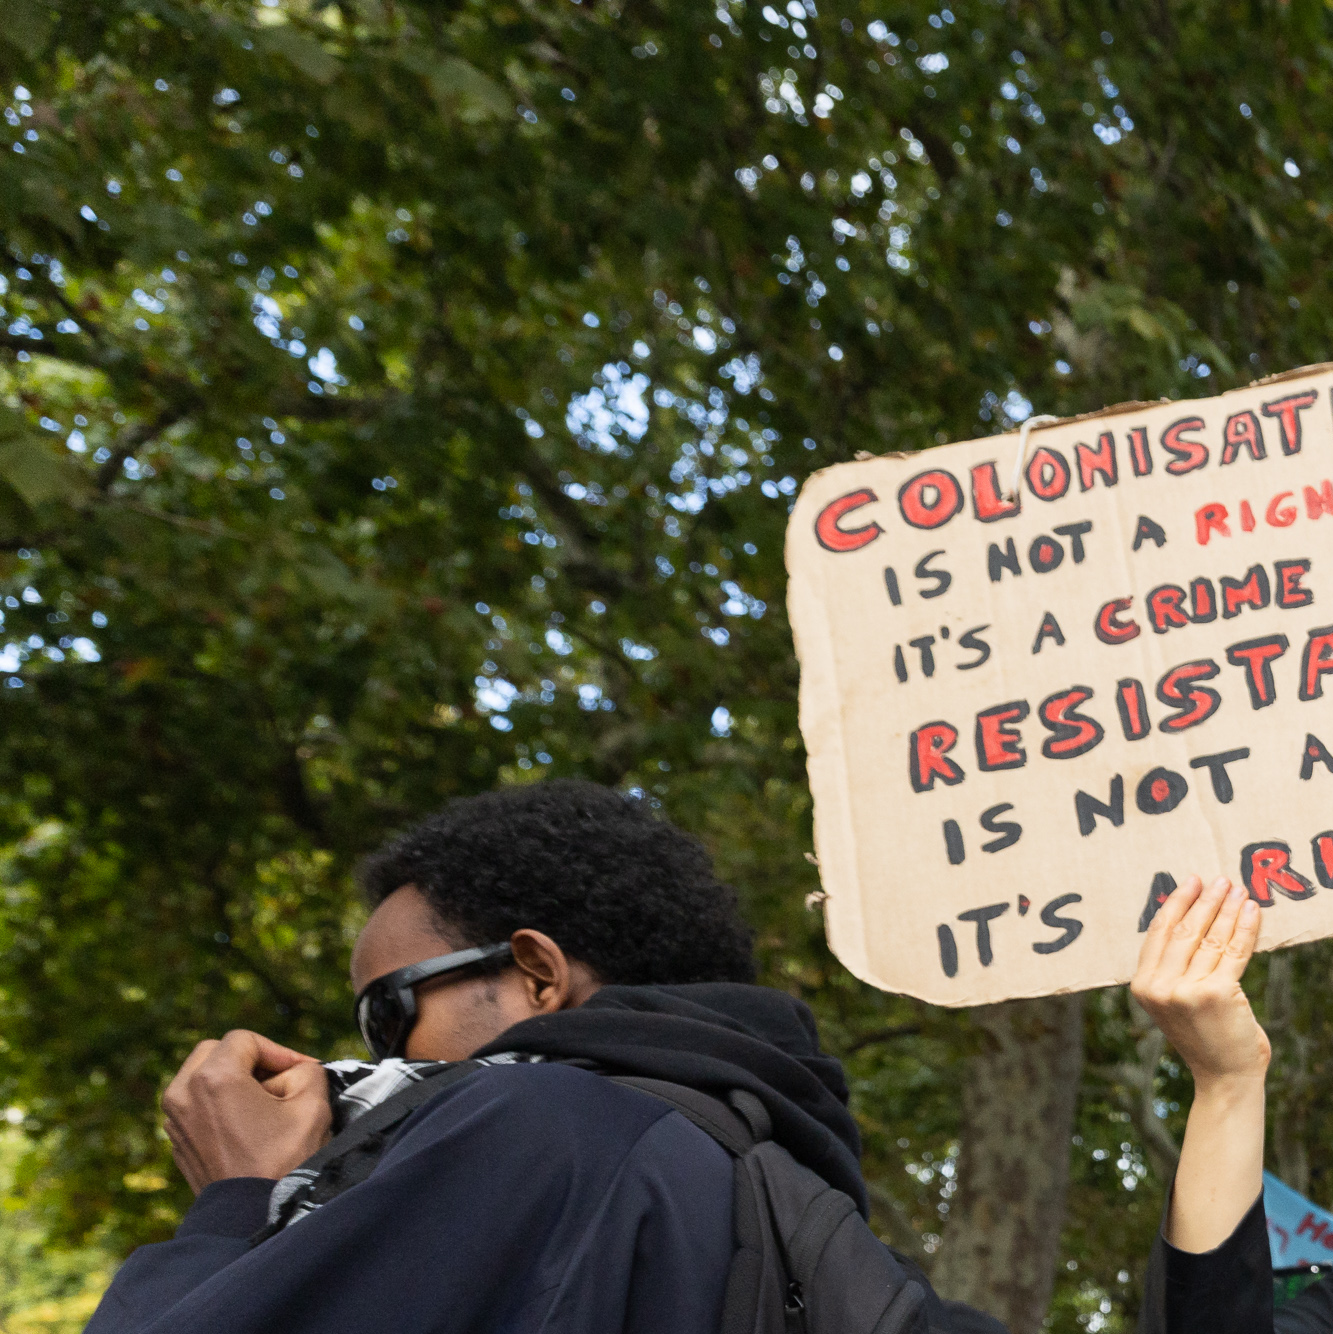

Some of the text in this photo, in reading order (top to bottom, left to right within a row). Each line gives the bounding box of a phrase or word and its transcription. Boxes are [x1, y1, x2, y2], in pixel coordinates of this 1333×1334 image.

[885, 549, 953, 607] IS
[988, 519, 1093, 583] NOT
[1132, 515, 1167, 550] A
[893, 558, 1316, 684] IT'S A CRIME
[943, 801, 1024, 866] IS
[1075, 747, 1252, 837] NOT
[936, 892, 1084, 978] IT'S
